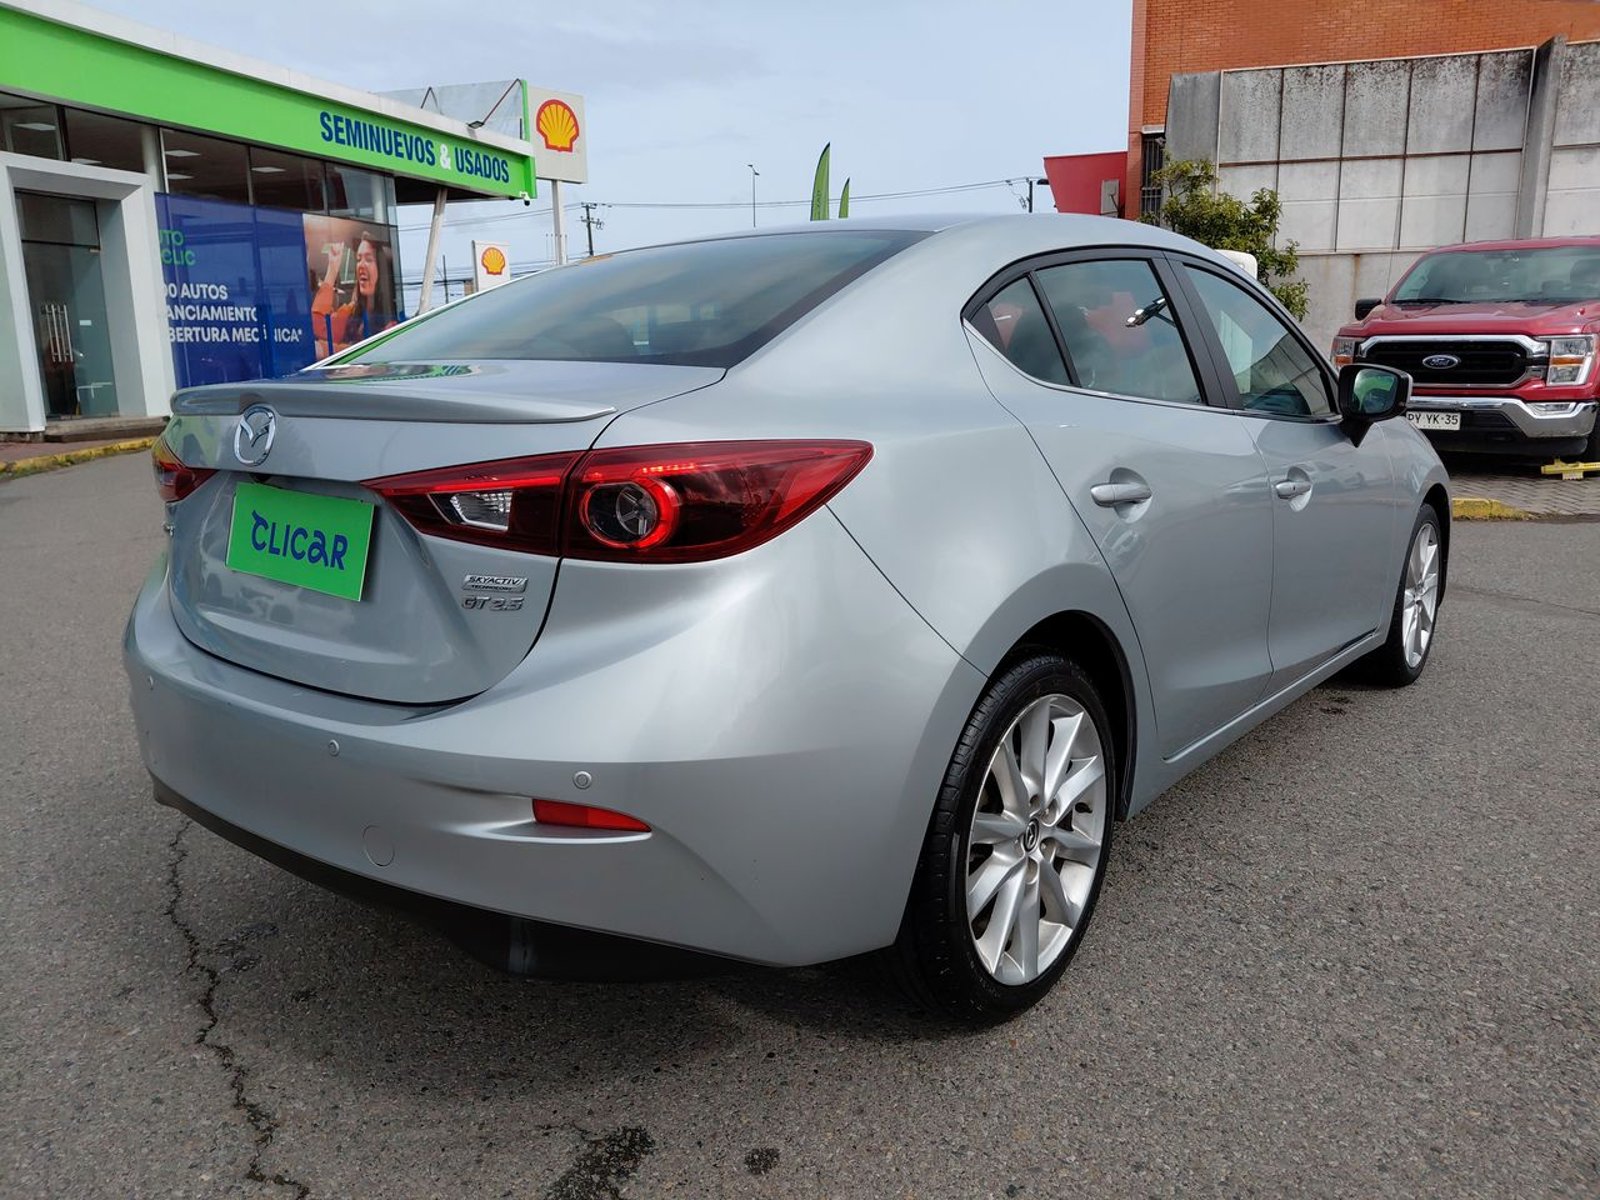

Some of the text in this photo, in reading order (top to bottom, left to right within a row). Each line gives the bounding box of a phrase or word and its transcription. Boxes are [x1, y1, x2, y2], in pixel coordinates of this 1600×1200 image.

[320, 111, 509, 184] SEMINUEVOS & USADOS
[161, 249, 196, 266] CLIC
[181, 283, 228, 300] AUTOS
[169, 327, 230, 342] BERTURA
[469, 576, 520, 585] SKYACTIV
[462, 596, 524, 612] GT 2.5
